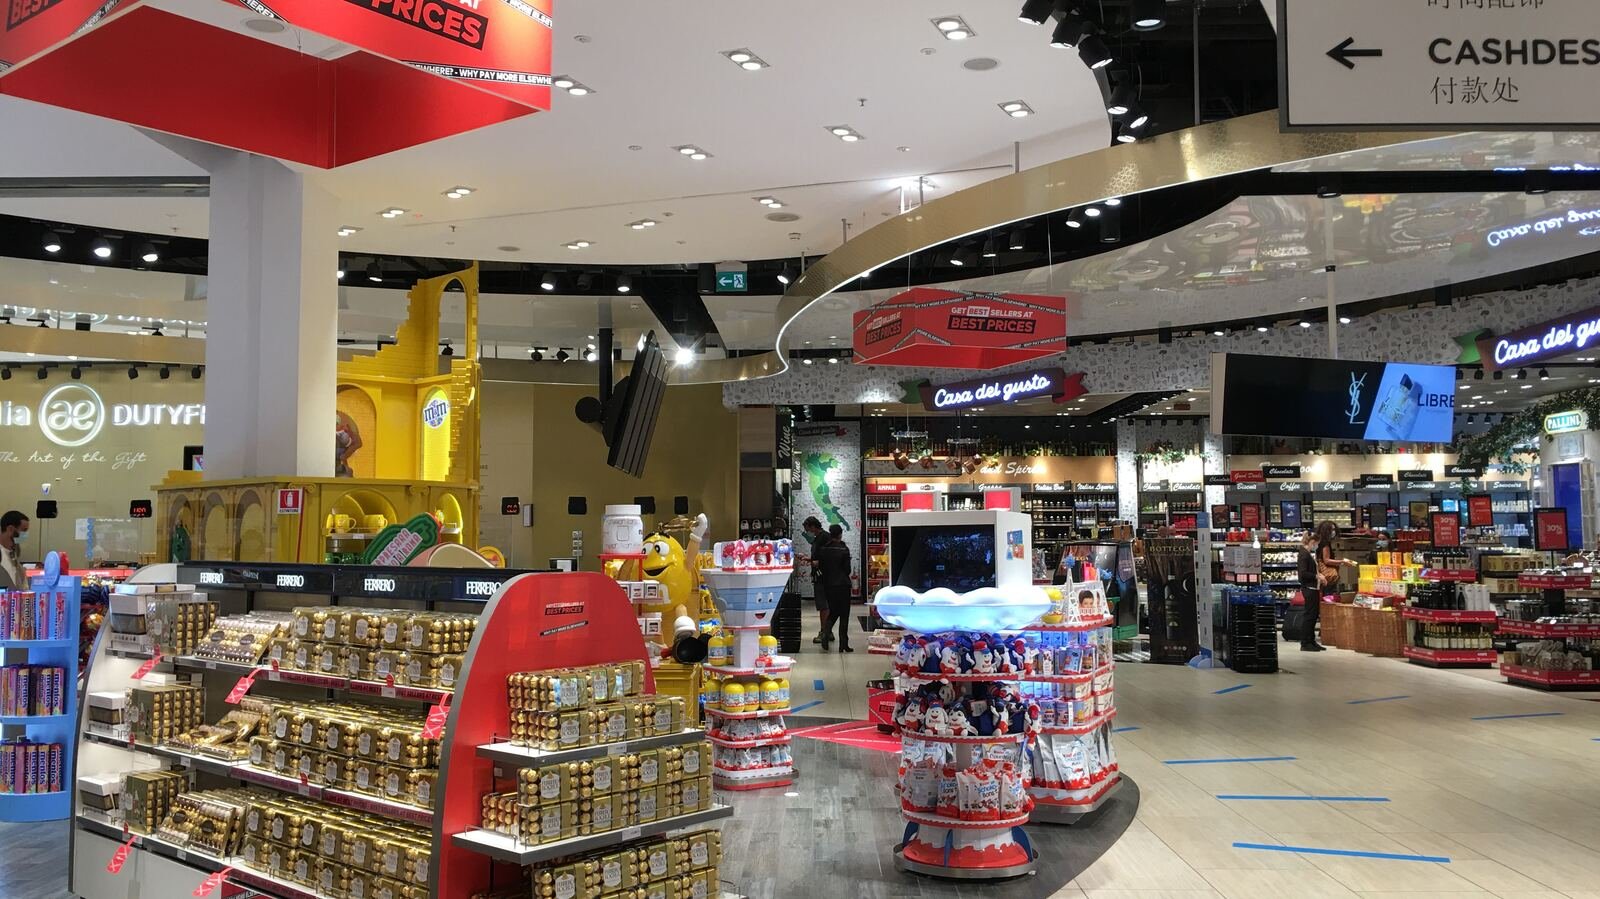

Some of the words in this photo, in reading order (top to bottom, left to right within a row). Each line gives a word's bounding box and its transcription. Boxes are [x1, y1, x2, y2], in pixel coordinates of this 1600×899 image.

[371, 0, 482, 44] RICES
[459, 69, 478, 79] WHY
[479, 70, 497, 80] PAY
[497, 72, 518, 82] MORE
[1430, 75, 1520, 105] 付款处
[951, 306, 967, 315] GET
[969, 307, 988, 316] BEST
[990, 309, 1023, 318] SELLERS
[951, 317, 985, 329] BEST
[986, 319, 1034, 332] PRICES
[1494, 336, 1541, 364] Casa
[1542, 323, 1574, 351] del
[934, 388, 974, 407] Casa
[975, 383, 1001, 401] del
[1002, 373, 1050, 400] gusto
[1546, 414, 1580, 429] PALLINI
[777, 425, 791, 459] Wine
[0, 450, 20, 463] The
[28, 449, 54, 463] Art
[60, 452, 75, 470] of
[82, 450, 106, 463] the
[112, 451, 147, 470] Gift
[791, 460, 801, 484] Wine
[1269, 467, 1294, 475] Chocolate
[1172, 483, 1201, 492] Chocolate
[1279, 481, 1301, 492] Coffee
[1323, 481, 1345, 492] Coffee
[1406, 481, 1435, 489] Souvenirs
[1493, 481, 1522, 489] Souvenirs
[200, 572, 224, 584] FERRERO
[277, 574, 305, 587] FERRERO
[363, 579, 395, 592] FERRERO
